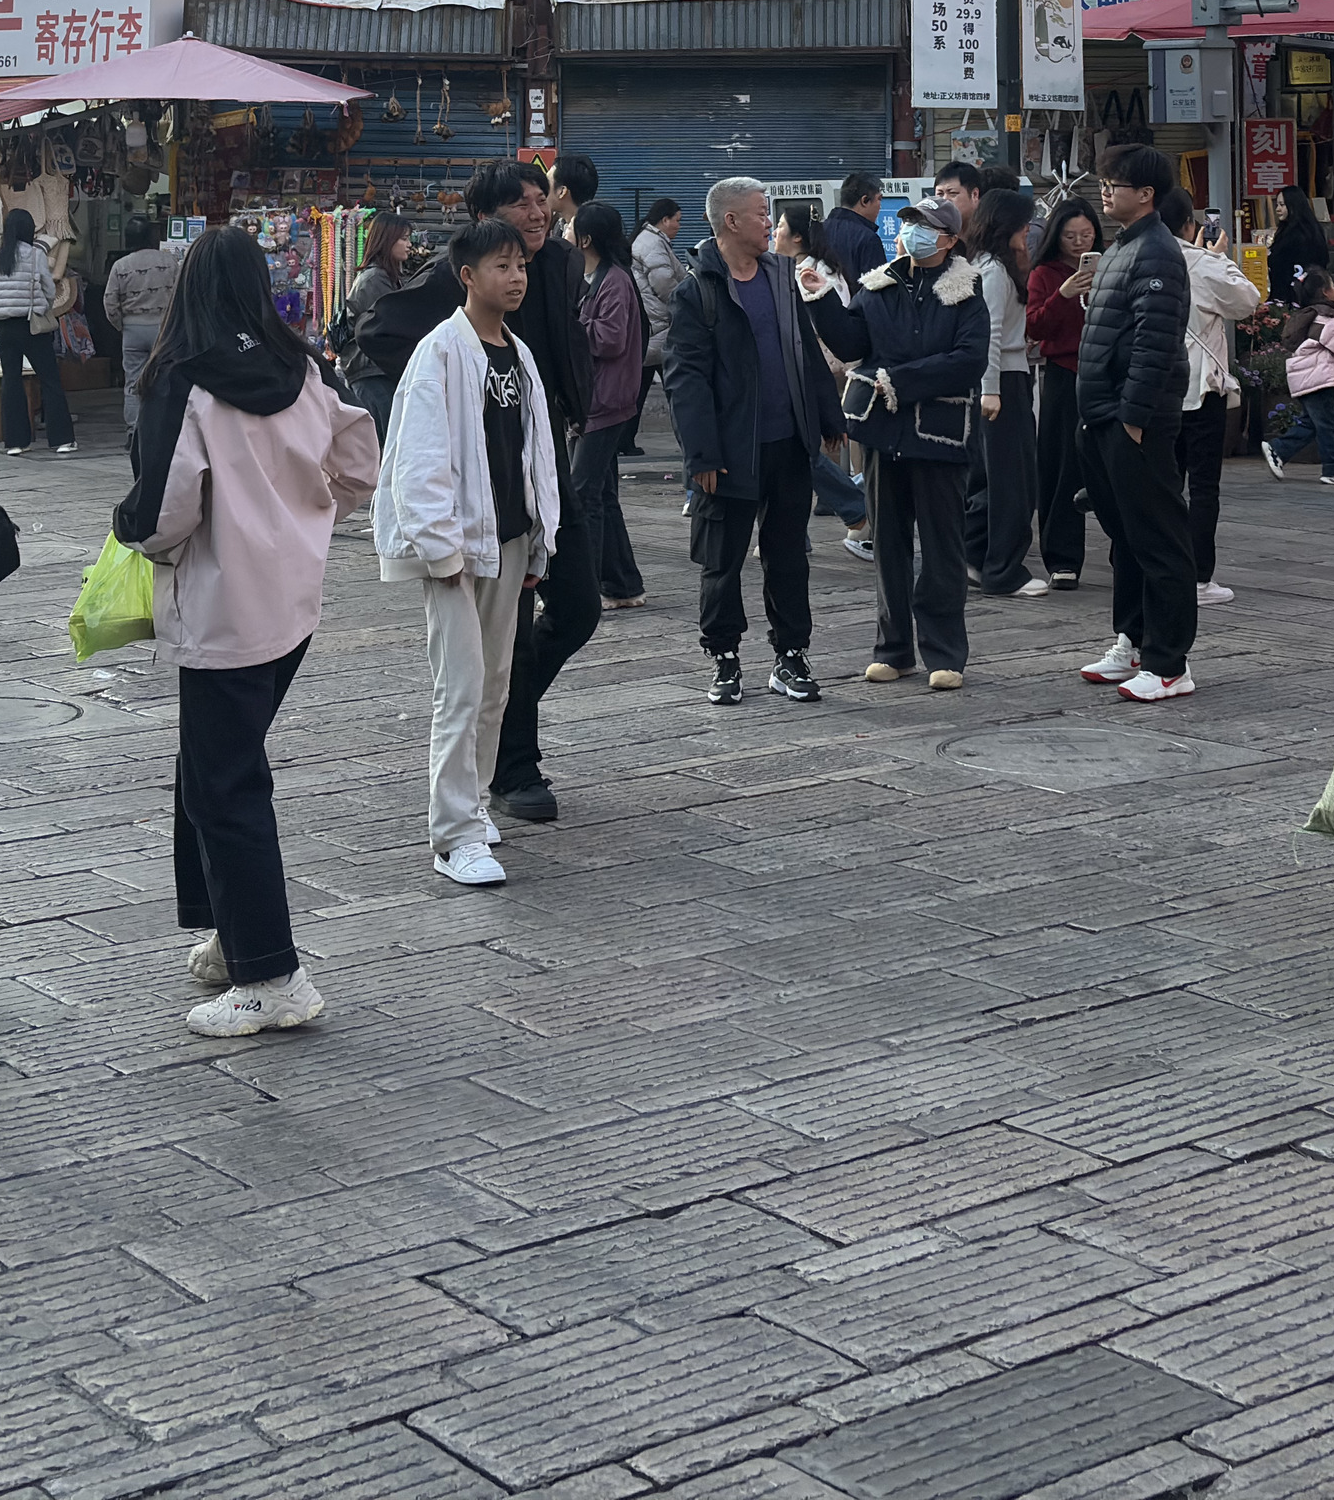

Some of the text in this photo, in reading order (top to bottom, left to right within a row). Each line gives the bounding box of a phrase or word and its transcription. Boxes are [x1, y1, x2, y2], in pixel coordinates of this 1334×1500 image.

[34, 6, 143, 66] 寄存行李
[1250, 124, 1290, 193] 刻章
[883, 215, 896, 236] 推
